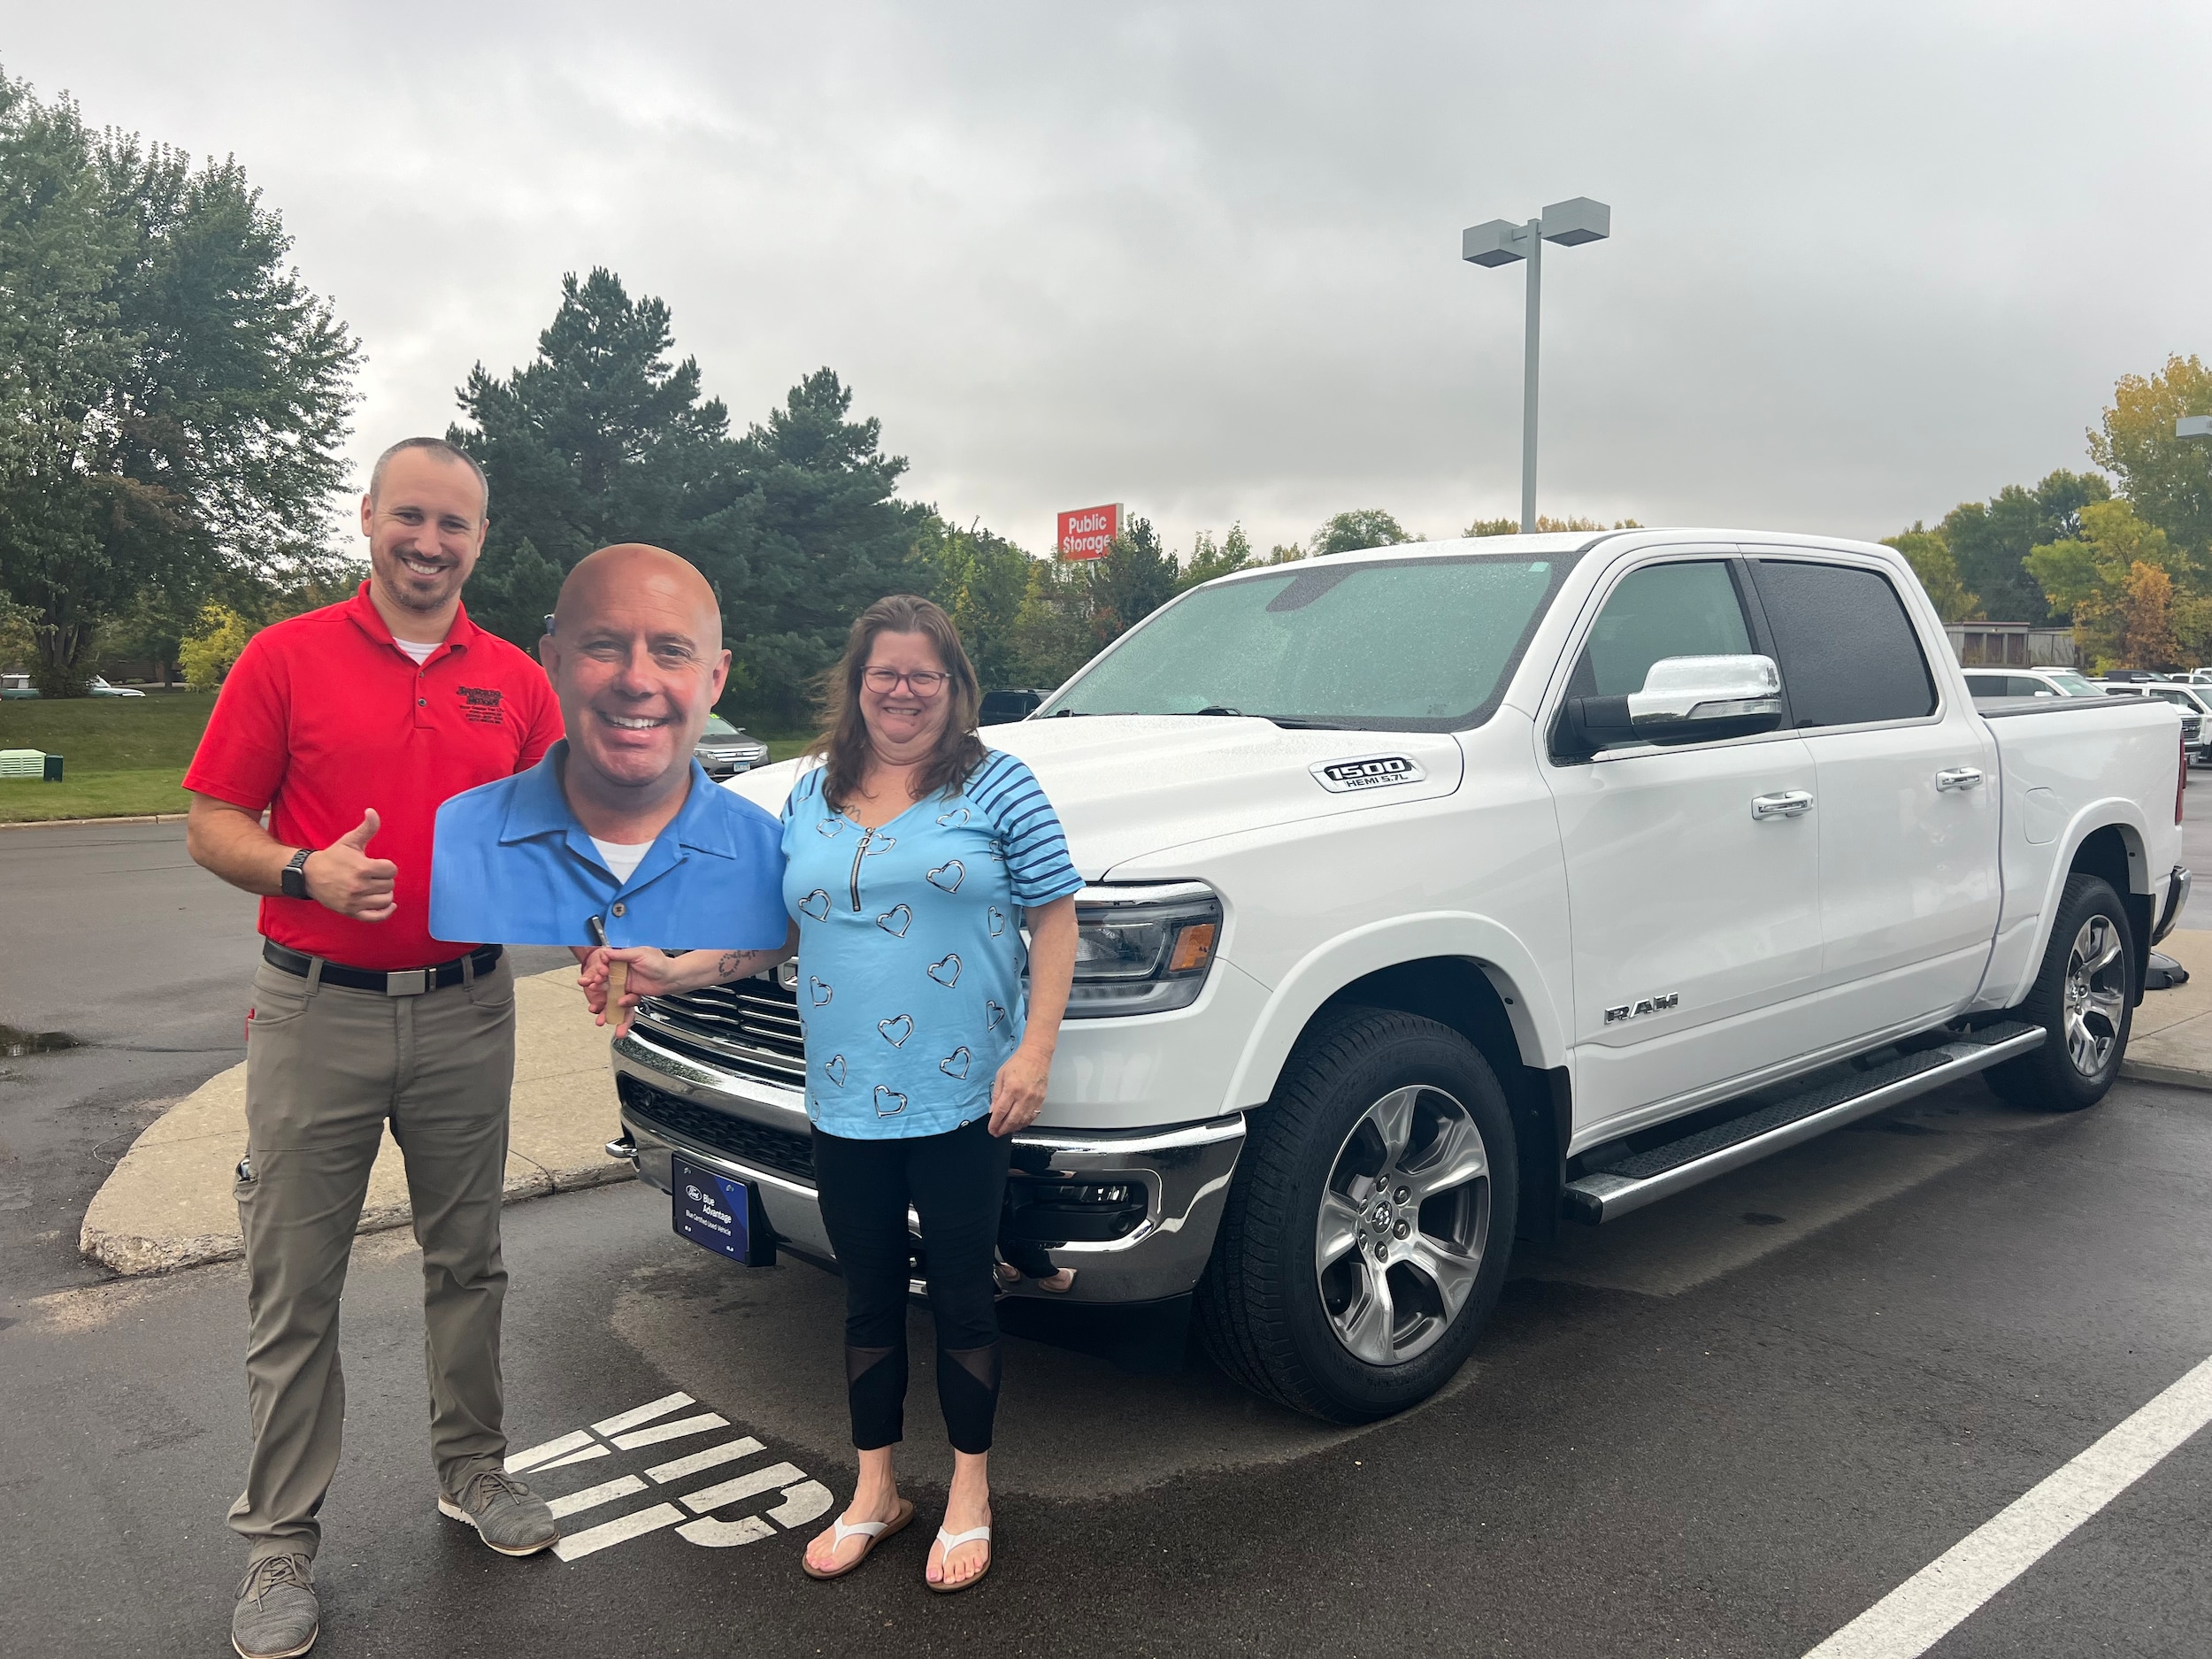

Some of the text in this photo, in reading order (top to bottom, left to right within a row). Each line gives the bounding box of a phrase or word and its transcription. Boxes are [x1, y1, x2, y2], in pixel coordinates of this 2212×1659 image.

[1069, 513, 1107, 534] Public
[1063, 534, 1112, 554] Storage
[1327, 759, 1407, 780] 1500
[1346, 774, 1409, 787] HEMI 5.7L
[1603, 991, 1678, 1025] RAM
[703, 1194, 715, 1206] Blue
[703, 1204, 733, 1225] Advantage
